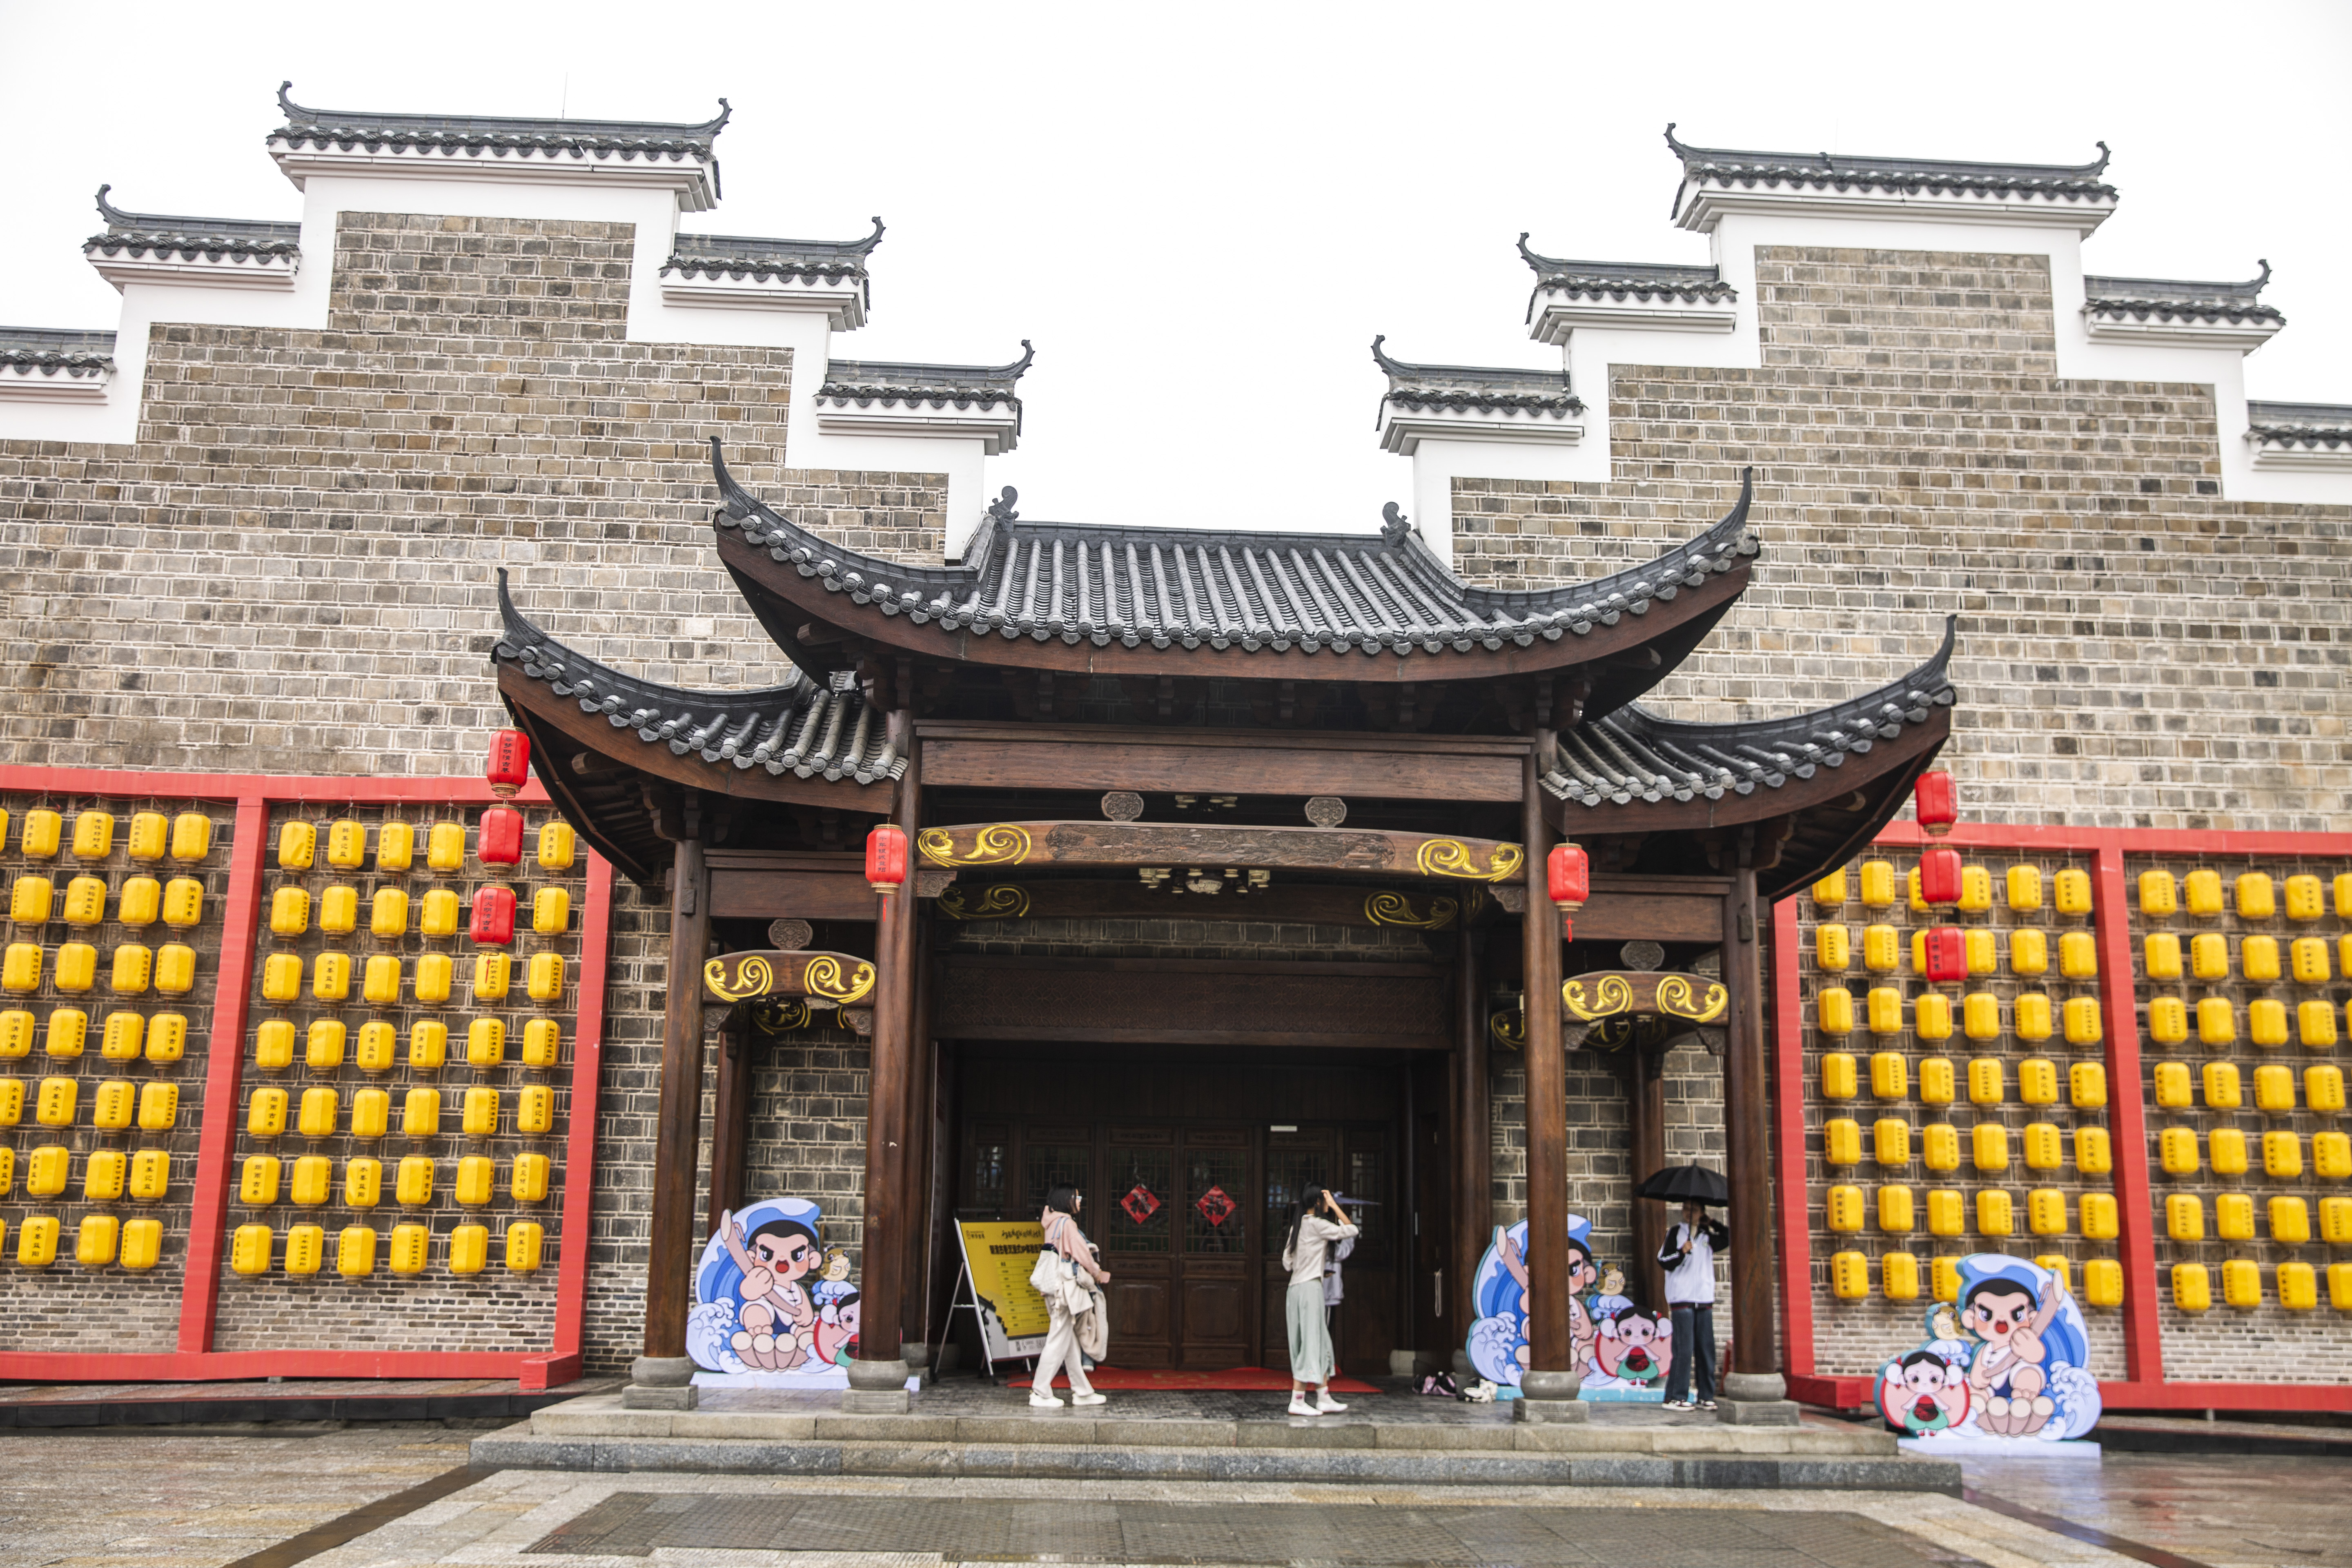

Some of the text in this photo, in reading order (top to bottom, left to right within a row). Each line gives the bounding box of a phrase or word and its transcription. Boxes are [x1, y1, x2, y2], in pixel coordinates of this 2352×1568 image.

[26, 817, 35, 846] 明清古巷
[187, 886, 196, 917] 明清古巷
[9, 1018, 20, 1049] 明清古巷
[168, 1022, 178, 1052] 明清古巷
[416, 1028, 425, 1058] 明清古巷
[1206, 1194, 1227, 1216] 福
